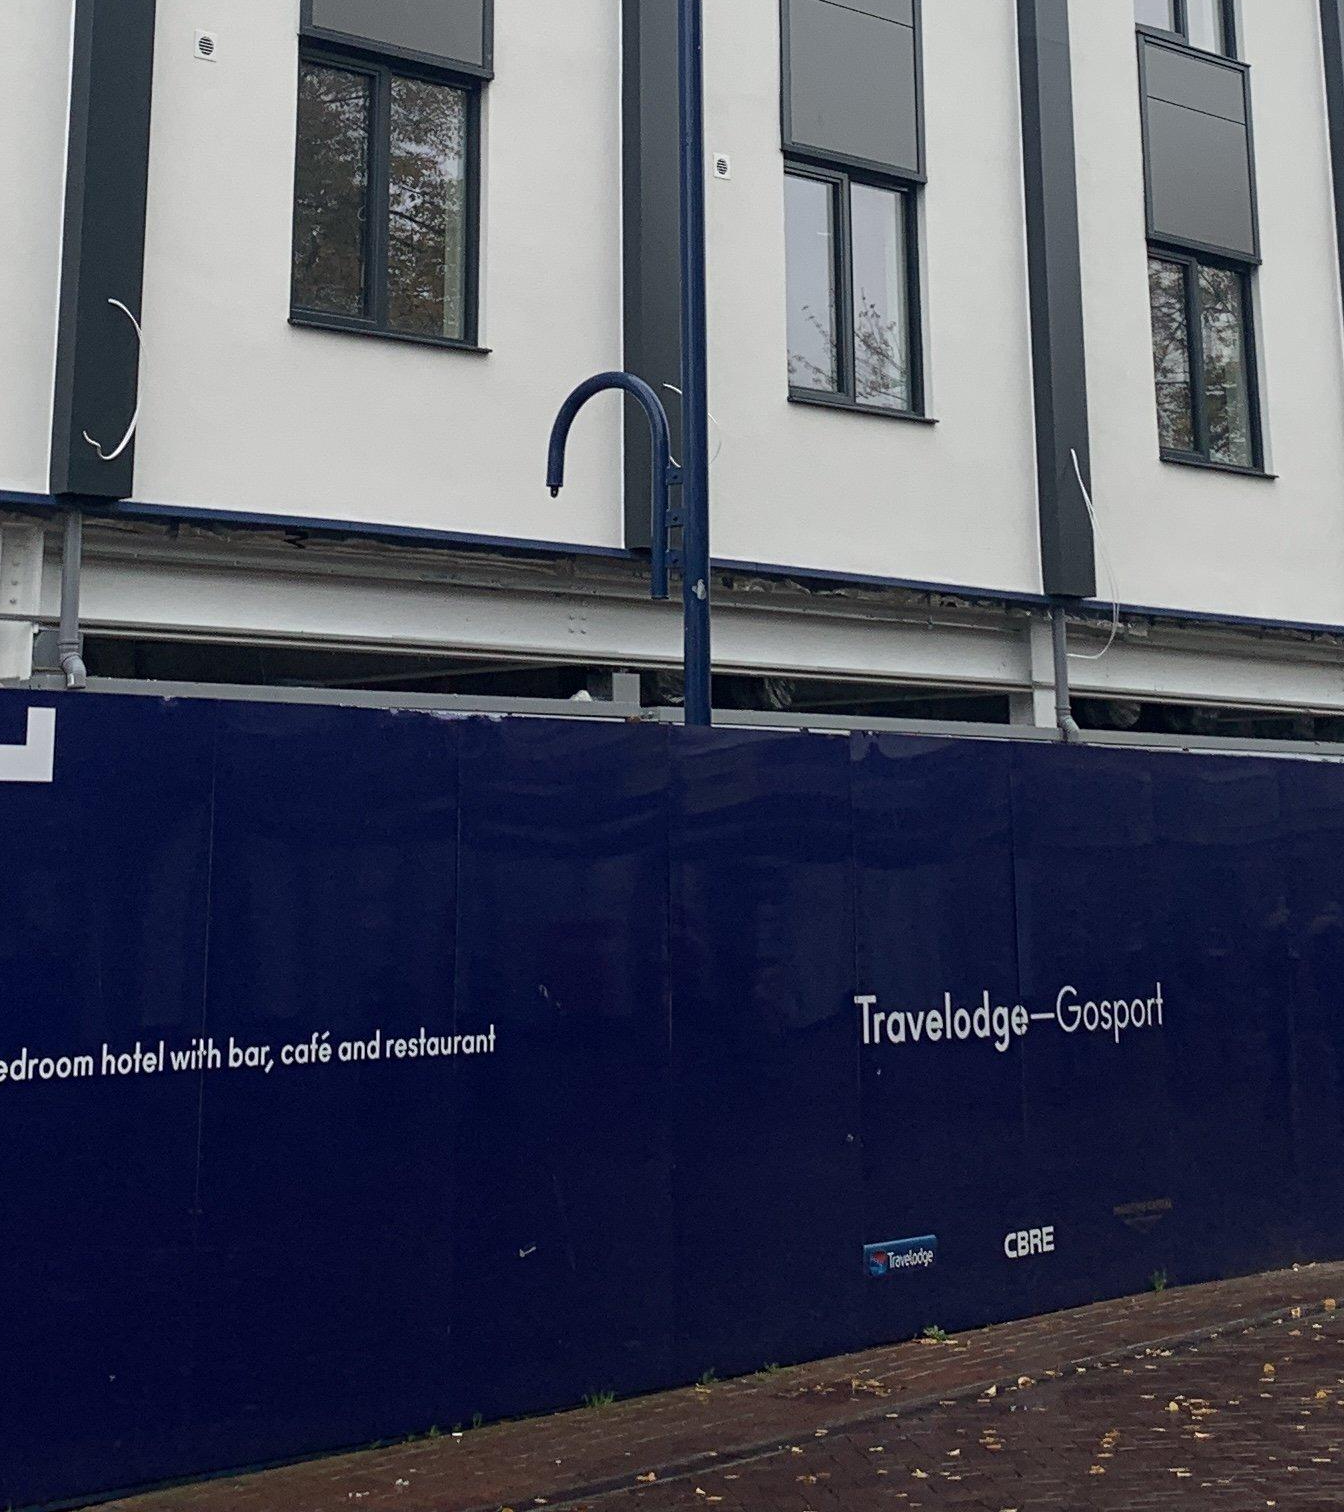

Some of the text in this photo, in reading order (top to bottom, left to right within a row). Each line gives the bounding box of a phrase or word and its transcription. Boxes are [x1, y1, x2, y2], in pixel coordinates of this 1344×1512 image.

[101, 1040, 165, 1075] hotel
[170, 1037, 221, 1070] with
[228, 1036, 274, 1074] bar,
[280, 1030, 332, 1065] café
[338, 1029, 380, 1061] and
[385, 1023, 496, 1058] restaurant
[886, 1247, 934, 1269] Travelodge
[1004, 1226, 1055, 1259] CBRE
